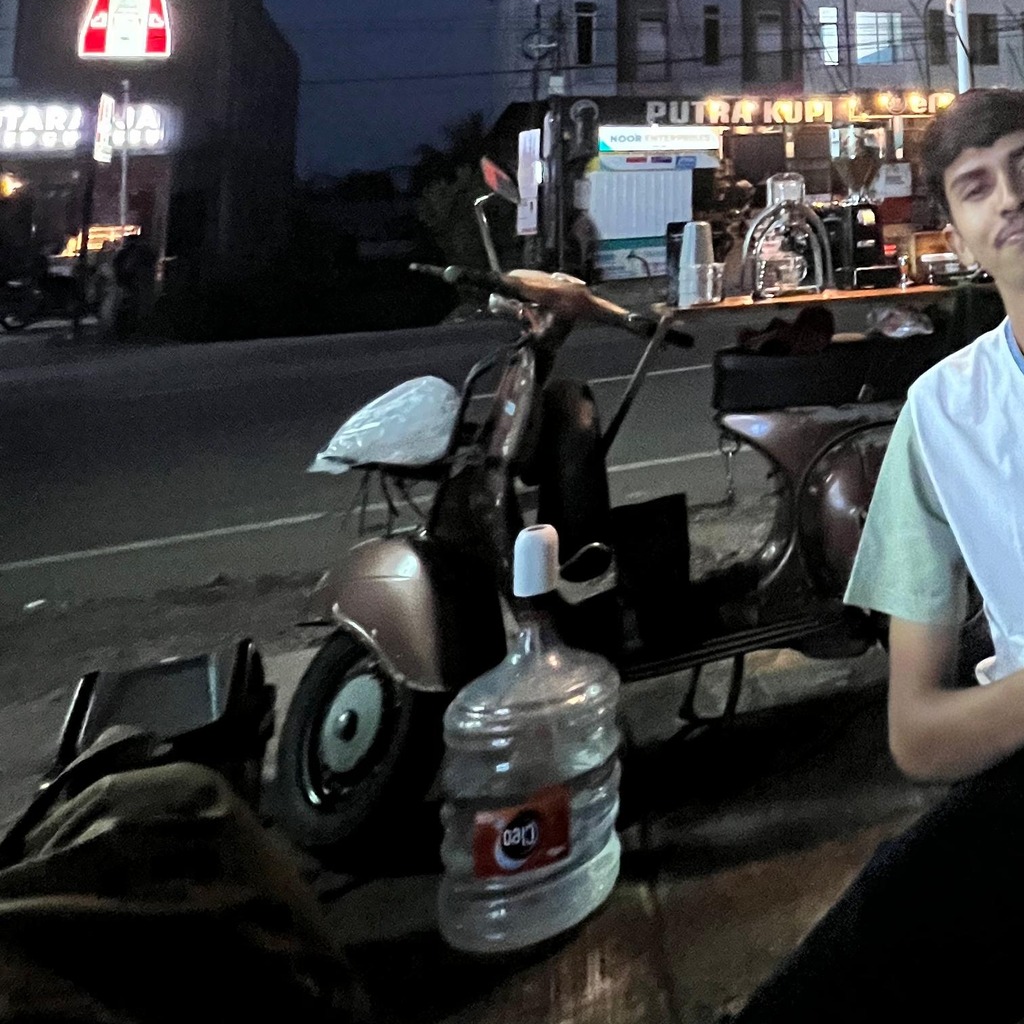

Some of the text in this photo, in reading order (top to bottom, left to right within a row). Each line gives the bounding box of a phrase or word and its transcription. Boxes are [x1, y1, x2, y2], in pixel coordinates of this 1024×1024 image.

[646, 100, 832, 124] PUTRA KUPI
[610, 134, 642, 143] NOOR
